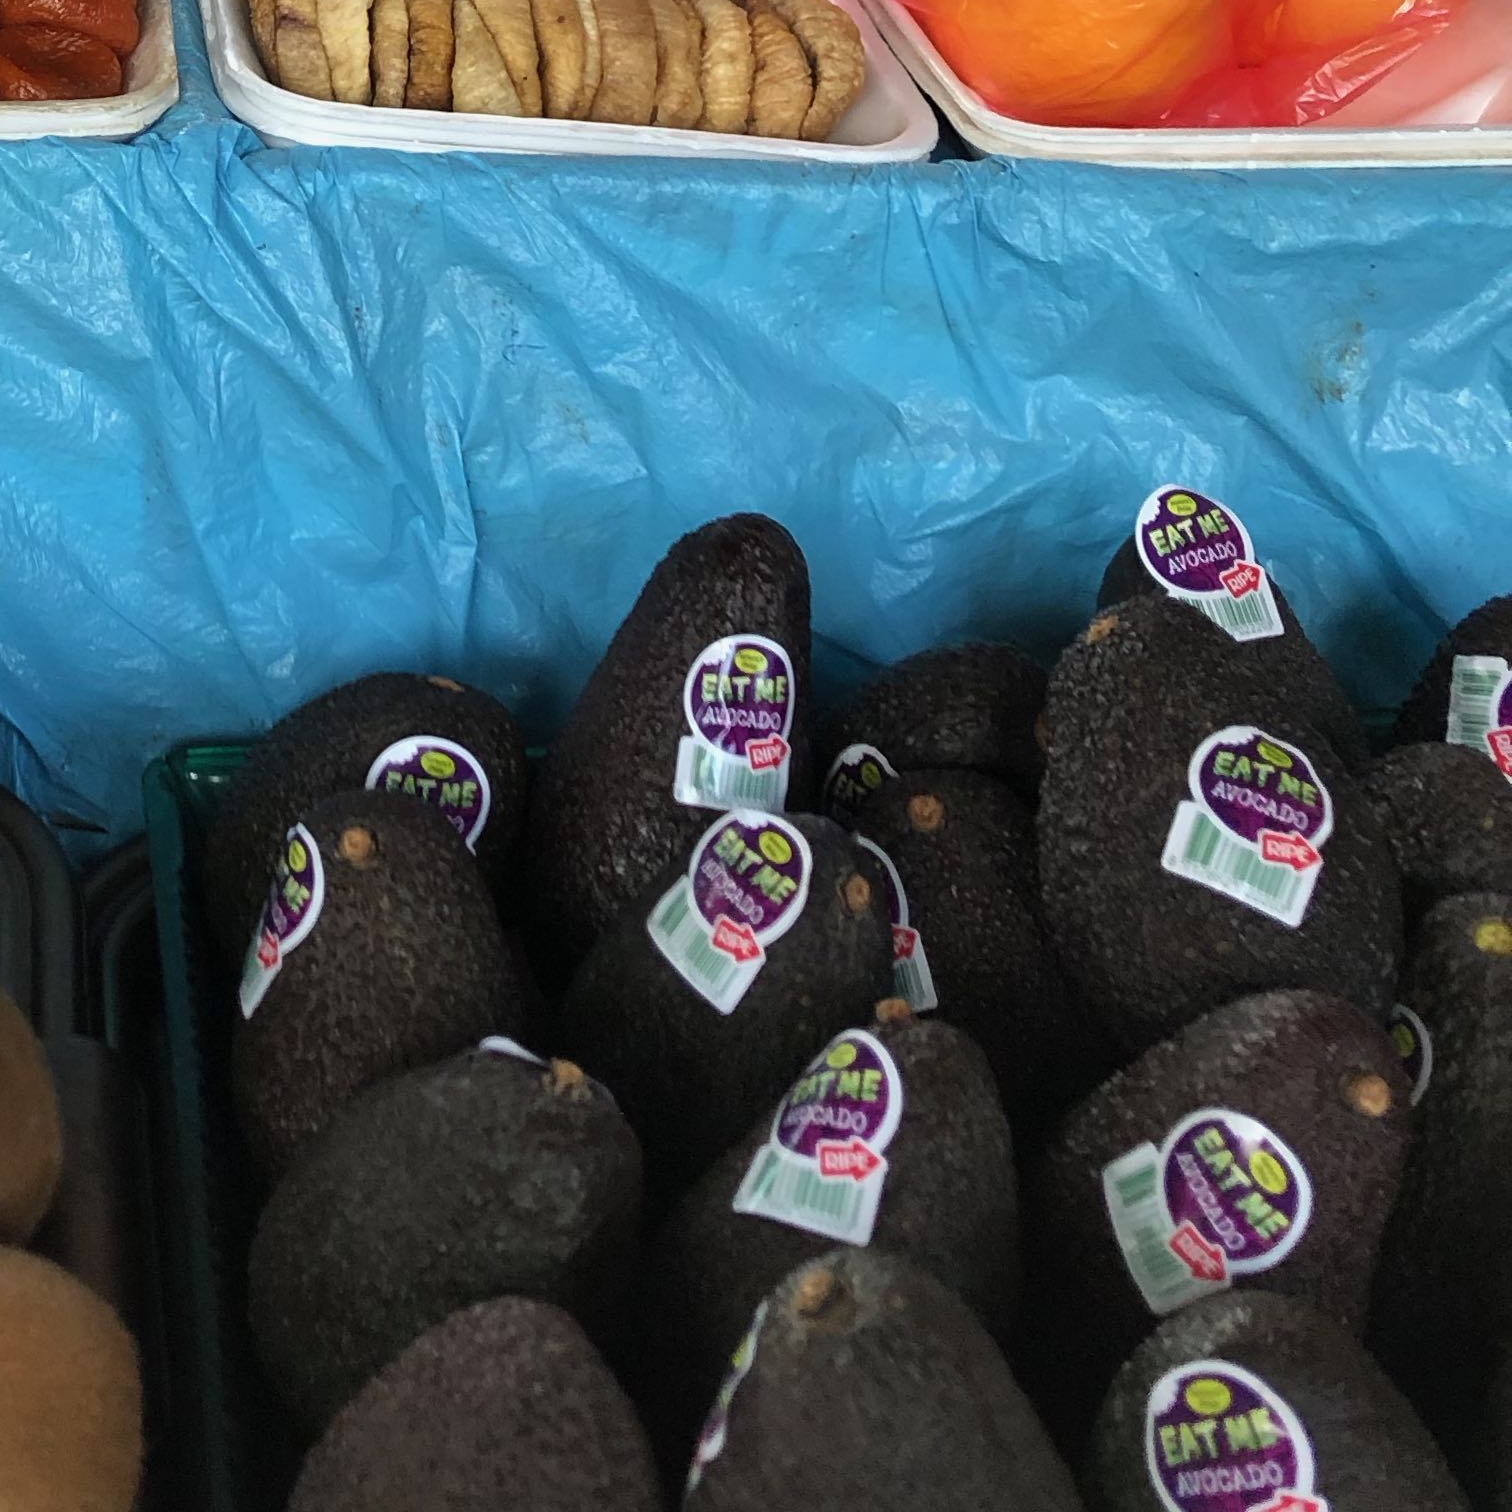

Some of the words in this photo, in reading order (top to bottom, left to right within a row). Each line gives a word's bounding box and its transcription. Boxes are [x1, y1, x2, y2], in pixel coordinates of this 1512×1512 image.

[1148, 518, 1196, 557] EAT
[1196, 509, 1230, 538] ME
[1168, 540, 1238, 575] AVOCADO
[1227, 567, 1257, 592] RIPE
[701, 673, 751, 703] EAT
[754, 675, 787, 704] ME
[702, 706, 782, 731] AVOCADO
[439, 780, 478, 807] ME
[1213, 751, 1276, 788] EAT
[1277, 771, 1318, 807] ME
[1211, 780, 1310, 831] AVOCADO
[713, 828, 763, 874] EAT
[750, 865, 797, 905] ME
[1267, 841, 1309, 863] RIPE
[837, 1069, 882, 1103] ME
[1193, 1127, 1252, 1191] EAT
[1234, 1192, 1289, 1239] ME
[1159, 1418, 1219, 1467] EAT
[1223, 1407, 1279, 1453] ME
[1176, 1460, 1284, 1498] AVOCADO
